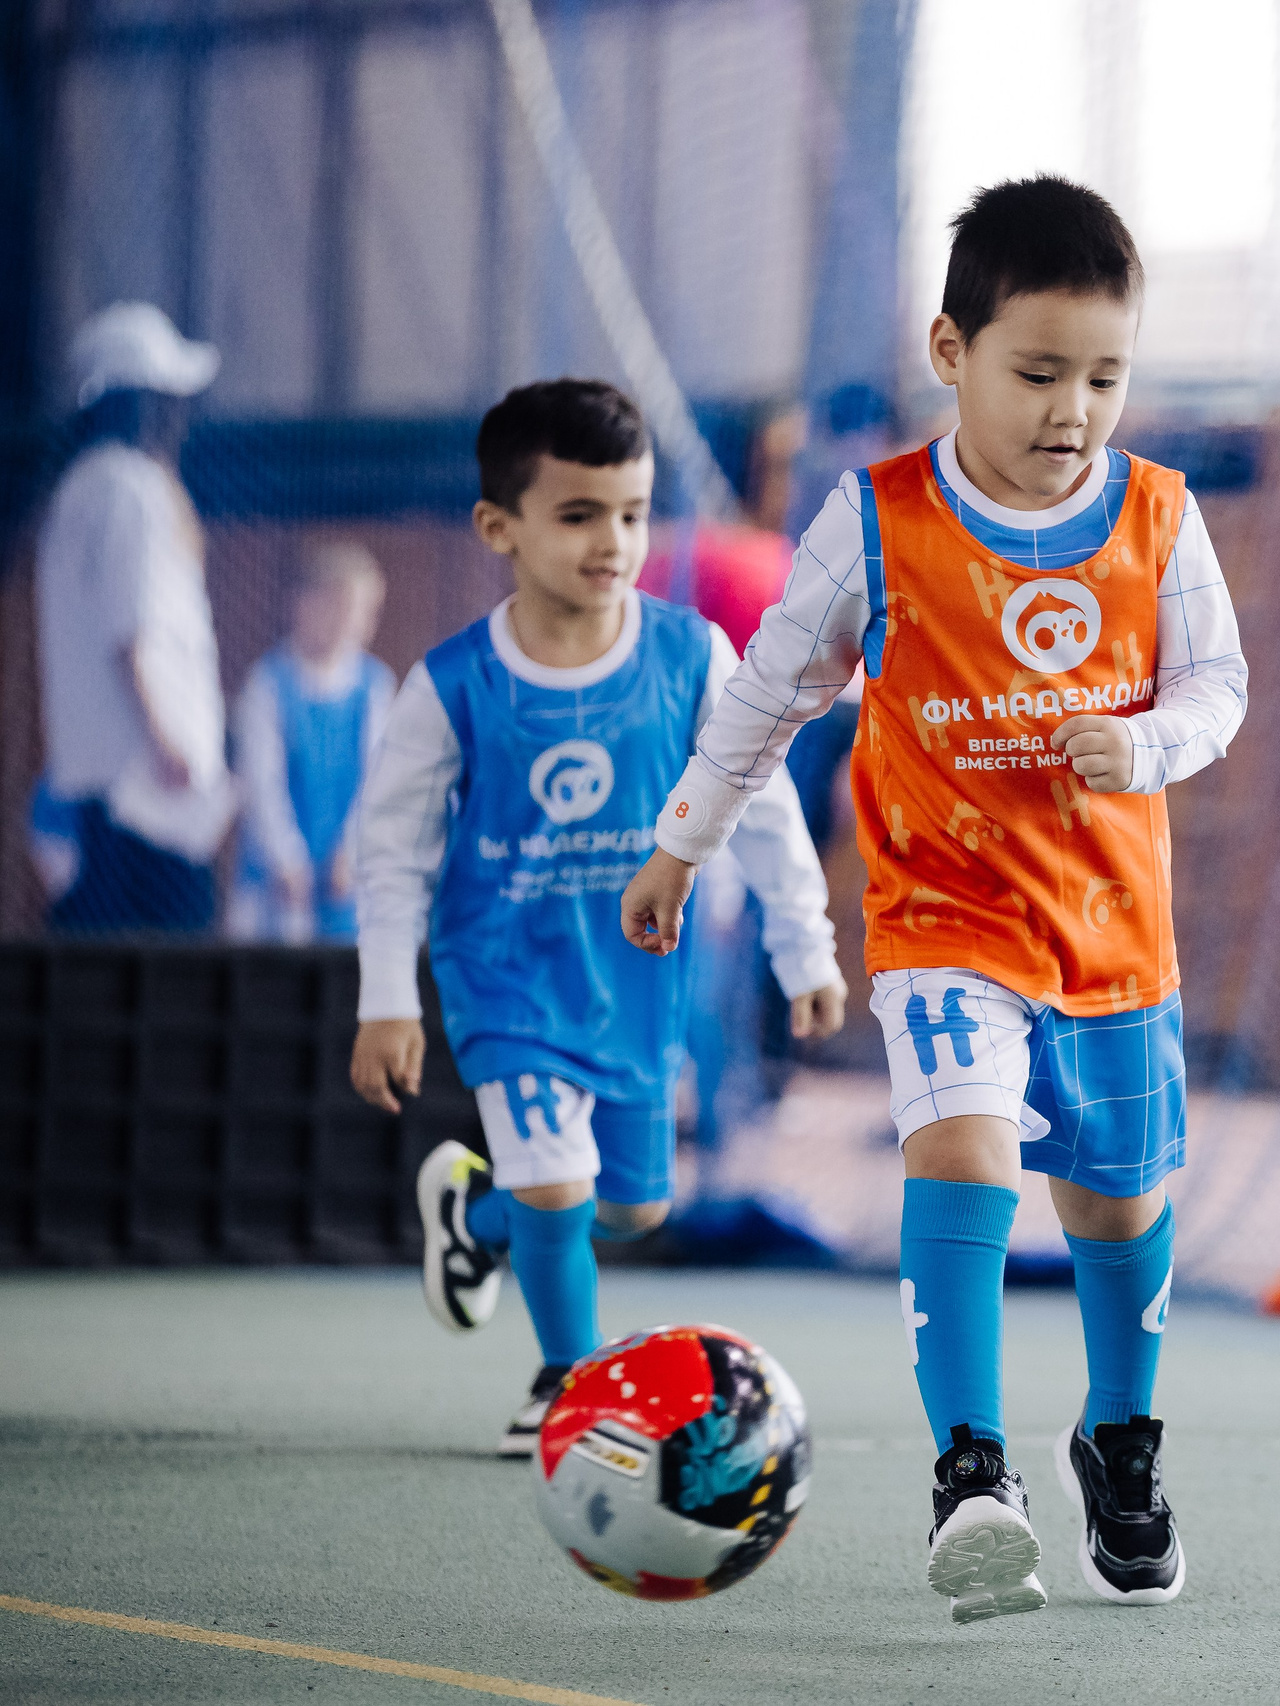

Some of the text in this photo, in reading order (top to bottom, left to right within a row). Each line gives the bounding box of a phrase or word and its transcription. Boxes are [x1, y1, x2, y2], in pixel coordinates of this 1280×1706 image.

[921, 697, 974, 724] ФК
[968, 733, 1045, 753] ВПЕРЁД
[954, 751, 1068, 771] ВМЕСТЕ МЫ
[674, 800, 691, 819] 8
